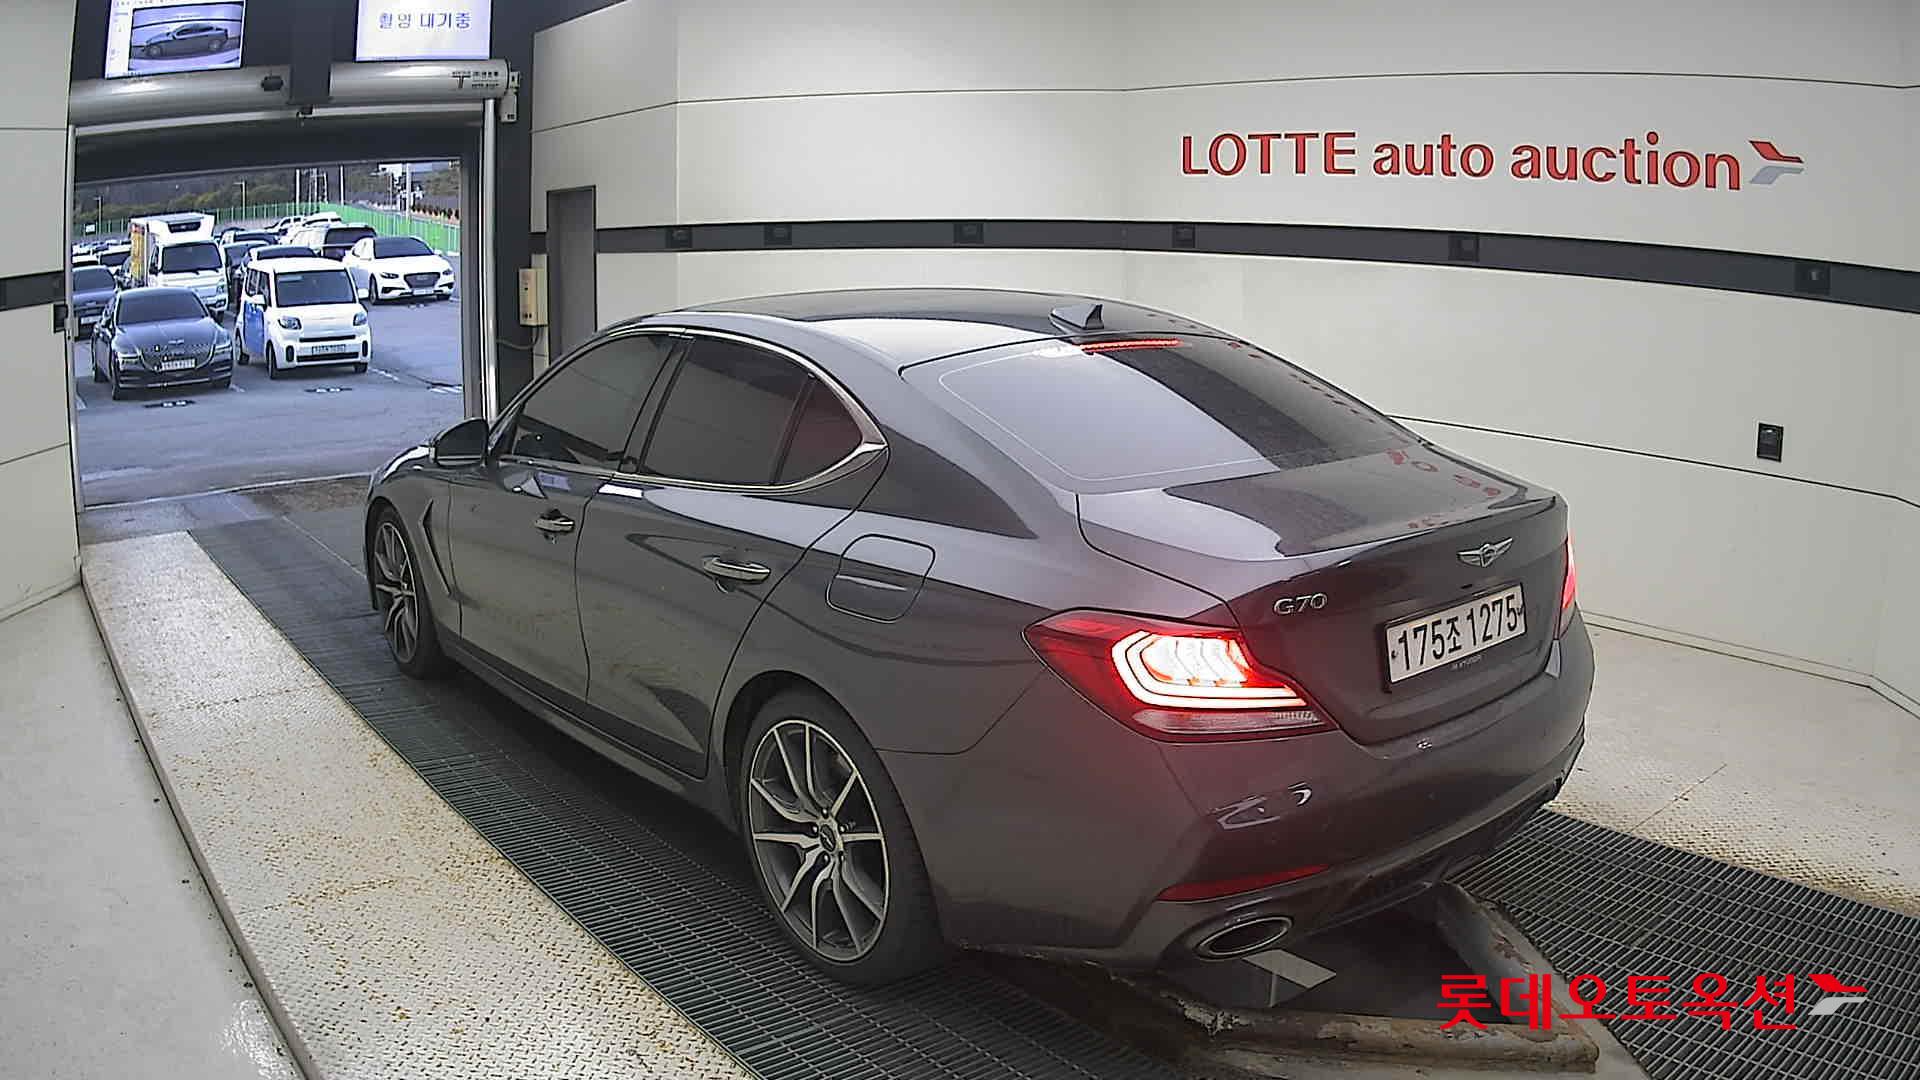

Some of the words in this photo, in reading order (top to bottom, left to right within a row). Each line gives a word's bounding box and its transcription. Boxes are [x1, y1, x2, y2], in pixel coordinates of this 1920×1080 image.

[420, 12, 470, 29] 대기중
[1182, 132, 1357, 175] LOTTE
[1374, 134, 1494, 177] auto
[1511, 131, 1741, 190] auction
[1274, 593, 1328, 616] G70
[1398, 616, 1462, 671] 175조
[1466, 594, 1518, 646] 1275
